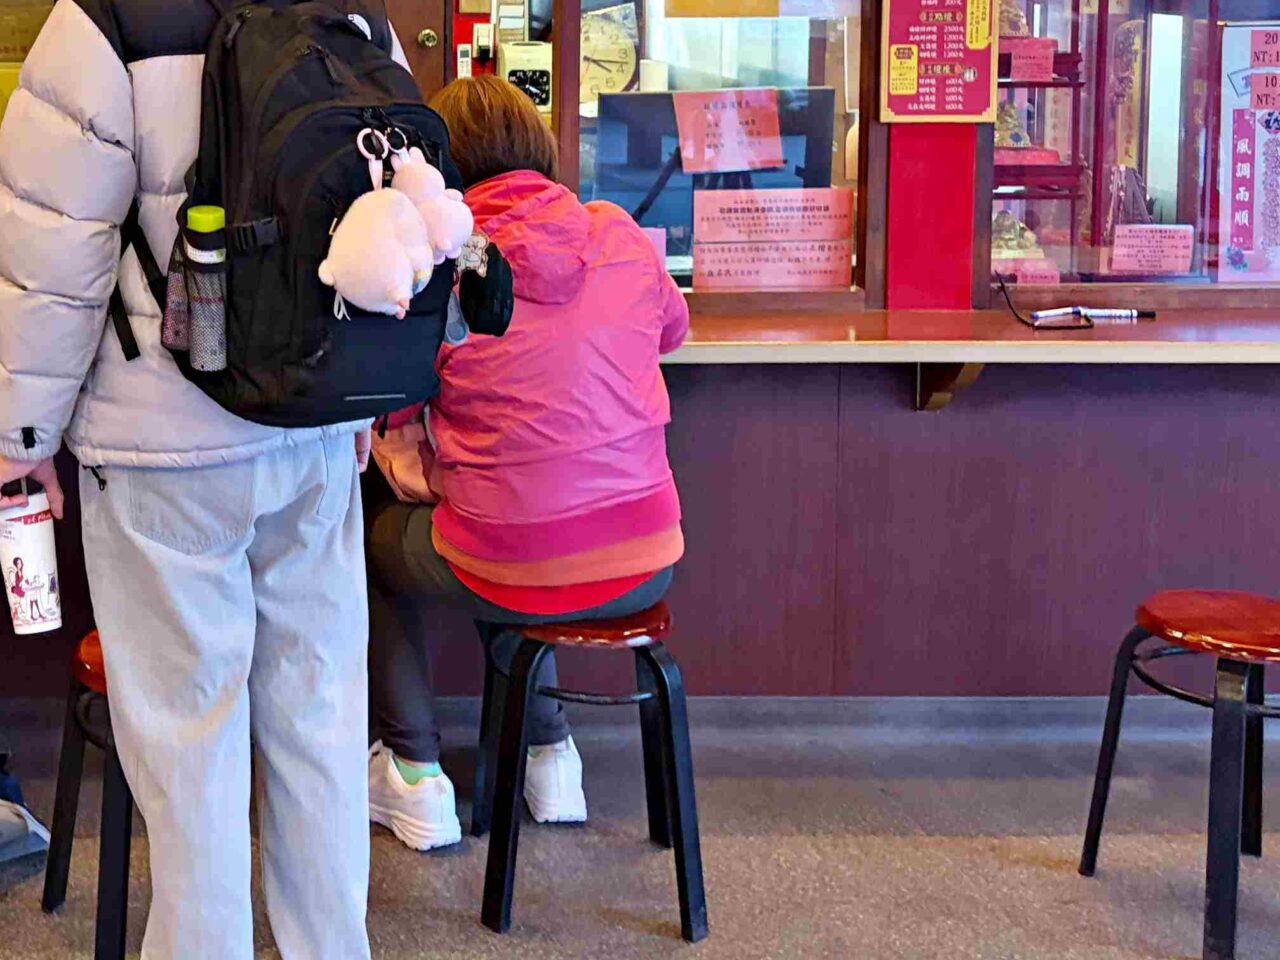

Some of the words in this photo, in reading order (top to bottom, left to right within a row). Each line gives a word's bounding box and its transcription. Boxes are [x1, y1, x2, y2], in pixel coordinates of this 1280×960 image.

[619, 48, 629, 60] 3
[616, 62, 626, 74] 4
[1235, 137, 1252, 227] 風調雨順
